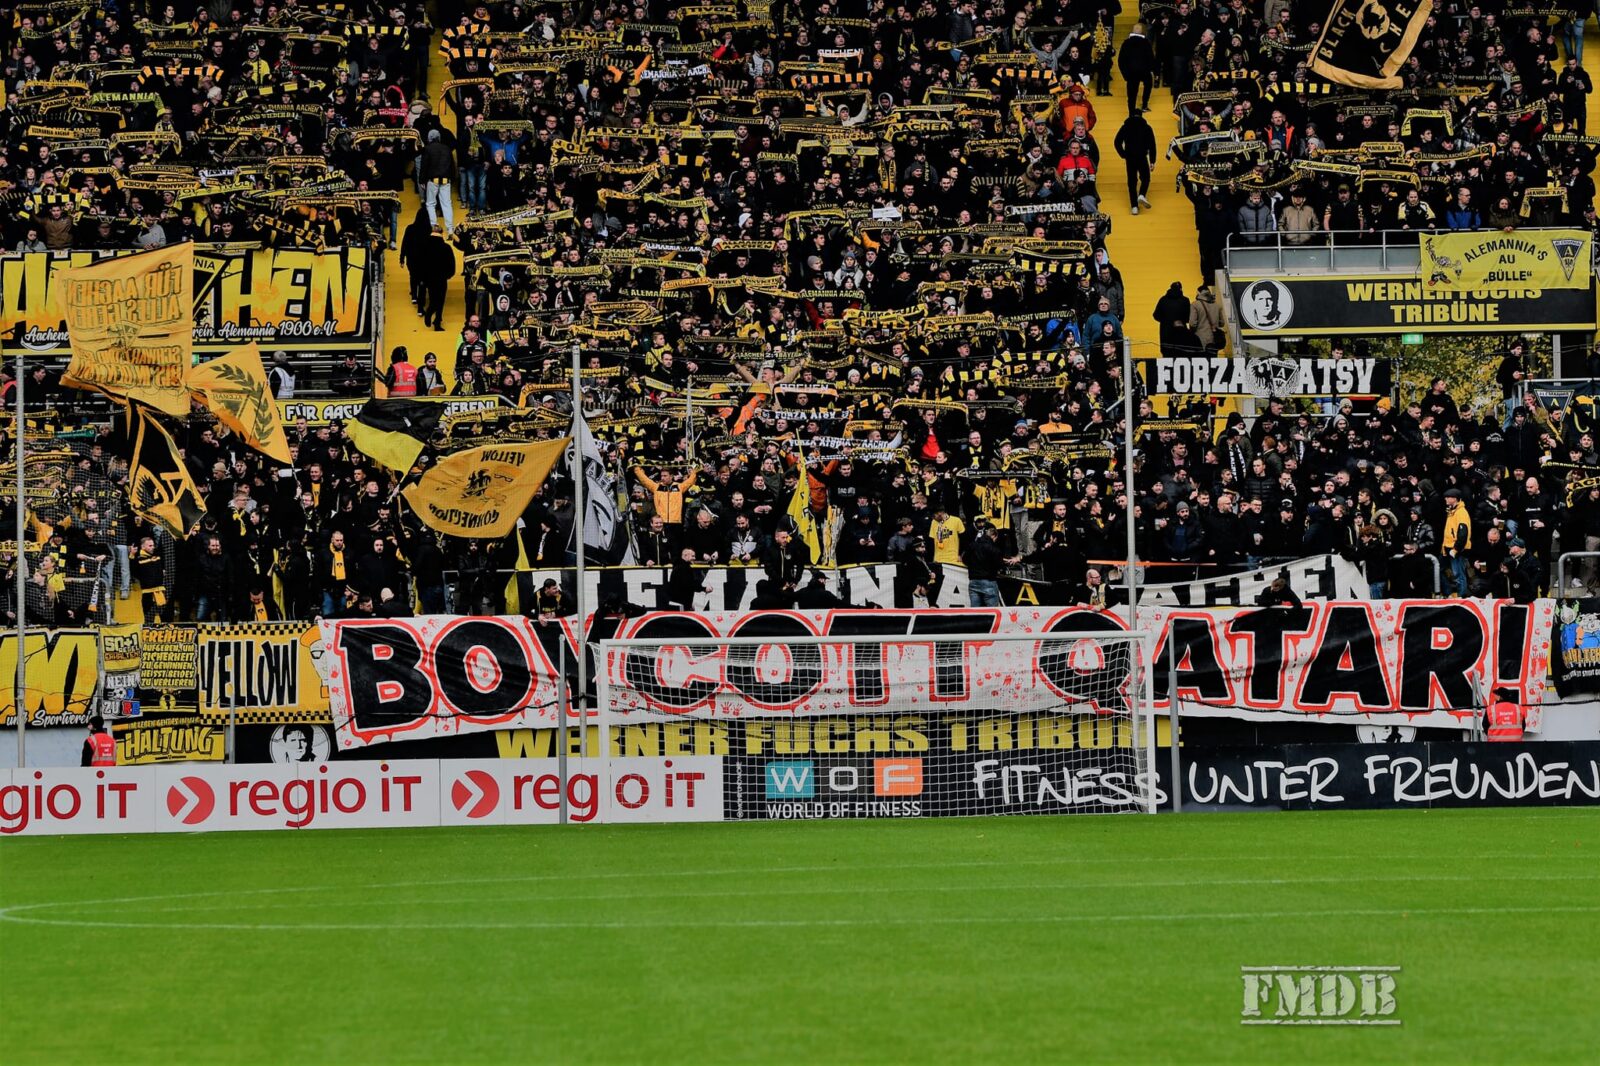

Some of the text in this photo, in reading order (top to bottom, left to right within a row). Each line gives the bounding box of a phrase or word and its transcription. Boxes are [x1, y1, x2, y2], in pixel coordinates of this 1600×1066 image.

[1320, 7, 1356, 60] BLACK
[92, 92, 157, 103] ALEMANNIA
[889, 119, 951, 133] AACHEN
[1463, 238, 1549, 263] ALEMANNIA'S
[1498, 254, 1516, 264] AU
[631, 287, 680, 299] ALEMANNIA
[800, 289, 838, 299] ALEMANNIA
[1390, 300, 1500, 323] TRIBÜNE
[25, 325, 69, 344] Aachene
[218, 322, 276, 337] Alemannia
[279, 320, 312, 337] 1900
[313, 320, 337, 336] e.V.
[1156, 357, 1376, 393] FORZA ATSV
[286, 403, 319, 421] FÜR
[323, 403, 364, 421] AACH
[142, 628, 195, 643] FREIHEIT
[142, 652, 195, 661] SICHERHEIT
[200, 639, 298, 708] YELLOW
[334, 600, 1537, 740] BOYCOTT QATAR!
[106, 674, 137, 689] NEIN
[153, 678, 195, 687] VERLIEREN
[103, 701, 120, 714] ZU
[31, 710, 93, 727] Sportverei
[124, 726, 214, 760] HALTUNG
[745, 716, 930, 755] FUCHS
[972, 753, 1600, 806] FITNESS UNTER FREUNDEN
[96, 769, 138, 820] iT
[229, 763, 422, 828] regio iT
[513, 773, 650, 823] rego
[664, 759, 705, 808] iT
[767, 801, 922, 819] WORLD OF FITNESS
